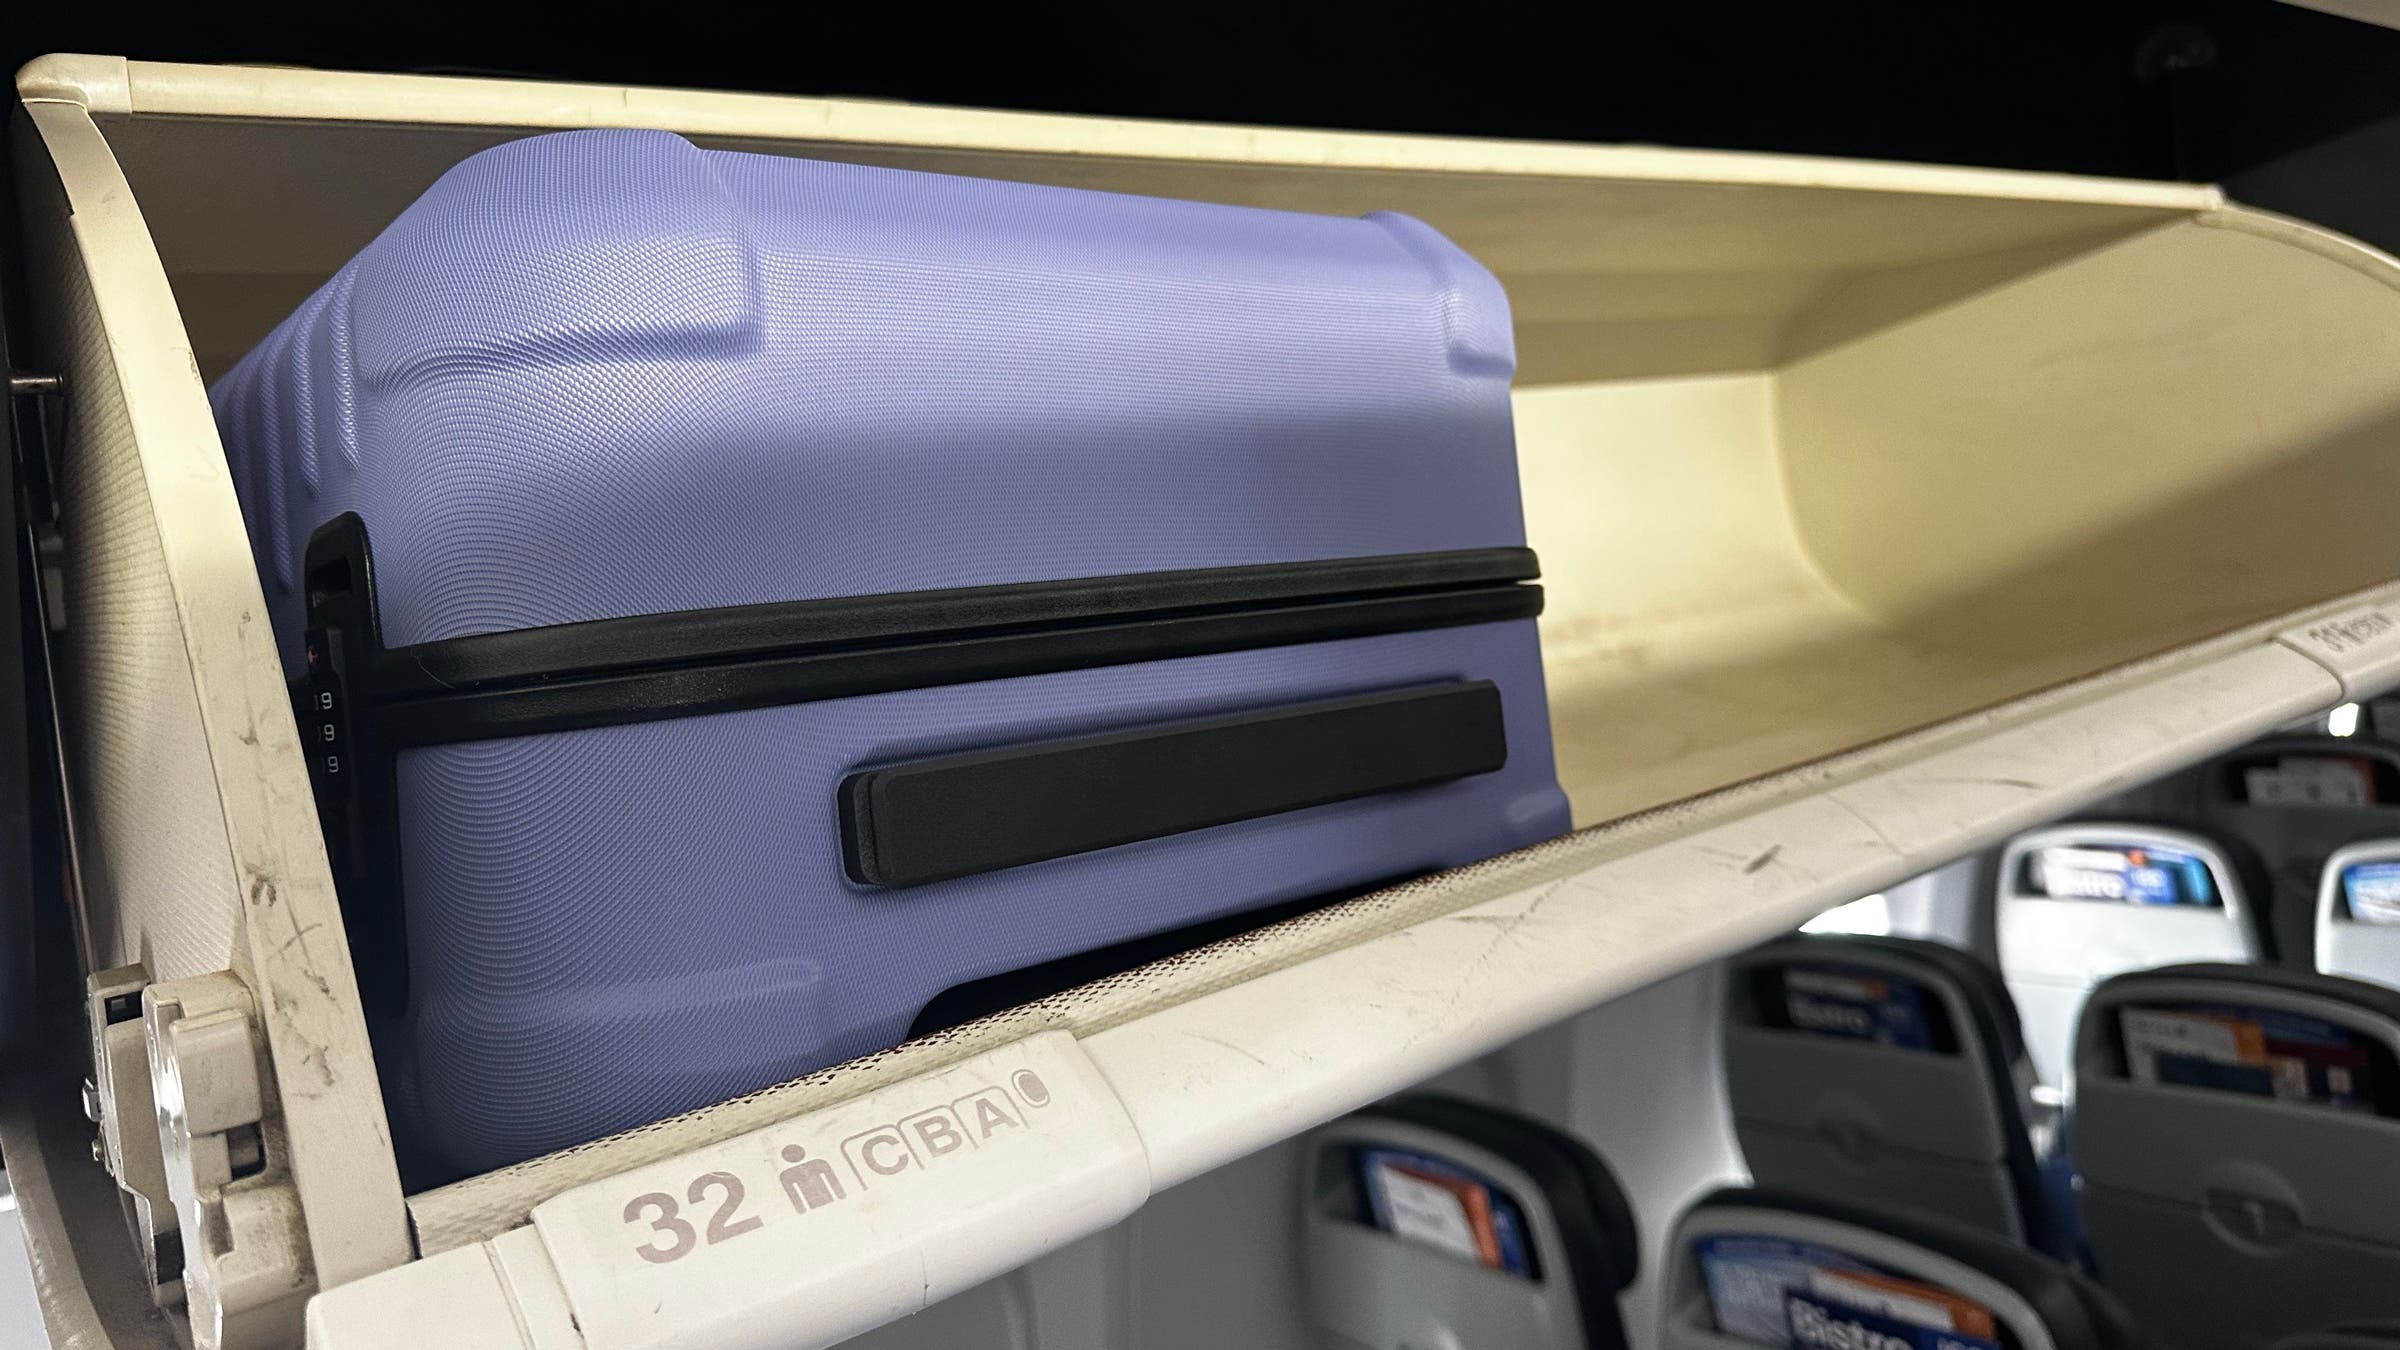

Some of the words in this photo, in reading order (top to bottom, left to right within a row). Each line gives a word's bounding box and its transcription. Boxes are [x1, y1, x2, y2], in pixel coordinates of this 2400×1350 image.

[320, 691, 333, 710] 9
[323, 723, 336, 742] 9
[327, 755, 340, 773] 9
[622, 1170, 765, 1264] 32
[861, 1134, 910, 1176] C
[913, 1114, 962, 1158] B
[975, 1097, 1019, 1139] A
